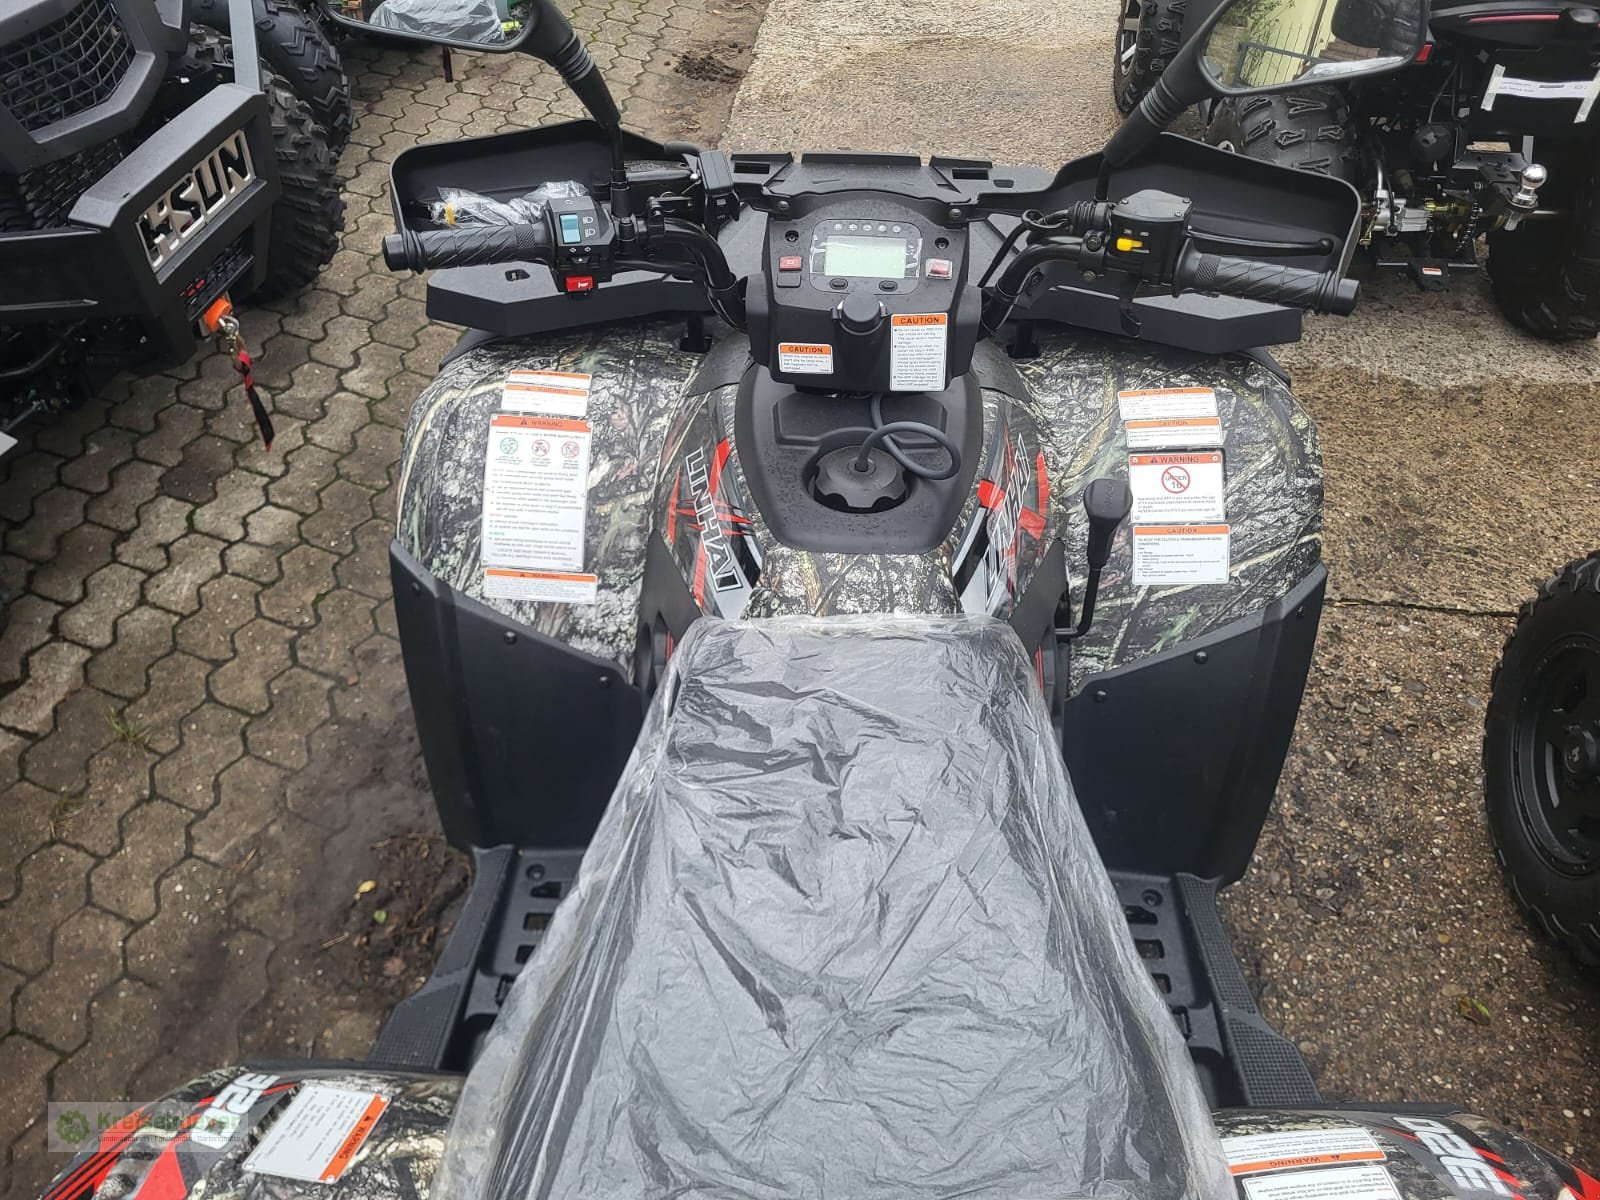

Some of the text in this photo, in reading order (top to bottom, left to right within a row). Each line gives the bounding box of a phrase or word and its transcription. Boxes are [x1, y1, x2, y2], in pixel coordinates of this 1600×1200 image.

[136, 129, 255, 267] HSUN
[900, 316, 940, 325] CAUTION
[531, 419, 564, 428] WARNING
[1160, 456, 1200, 464] WARNING
[685, 446, 744, 592] LINHAI
[1166, 527, 1198, 535] CAUTION
[338, 1127, 365, 1160] WARNING
[1268, 1157, 1320, 1168] WARNING
